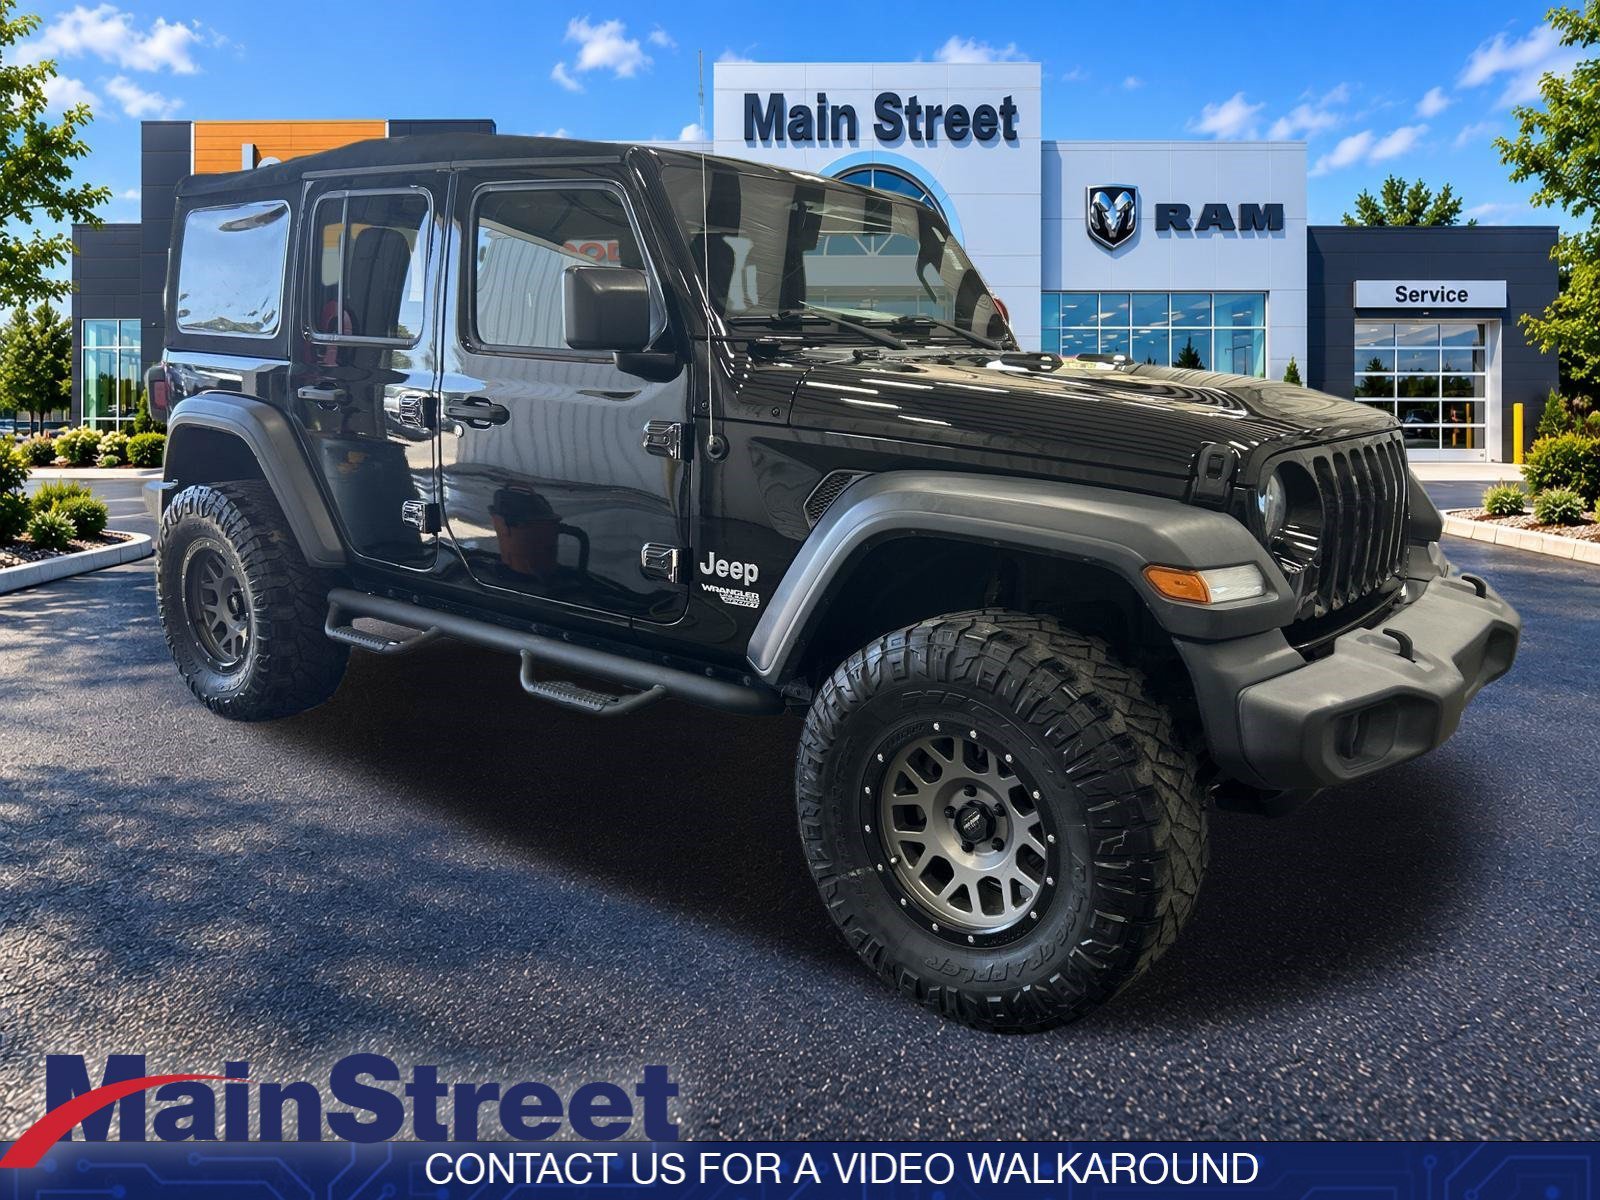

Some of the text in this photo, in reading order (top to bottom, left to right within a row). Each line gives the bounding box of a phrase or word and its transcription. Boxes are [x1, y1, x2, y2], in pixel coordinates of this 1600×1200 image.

[744, 91, 1018, 141] Main Street
[1155, 203, 1284, 232] RAM
[1395, 285, 1469, 303] Service
[699, 551, 759, 587] Jeep
[701, 583, 760, 599] WRANGLER
